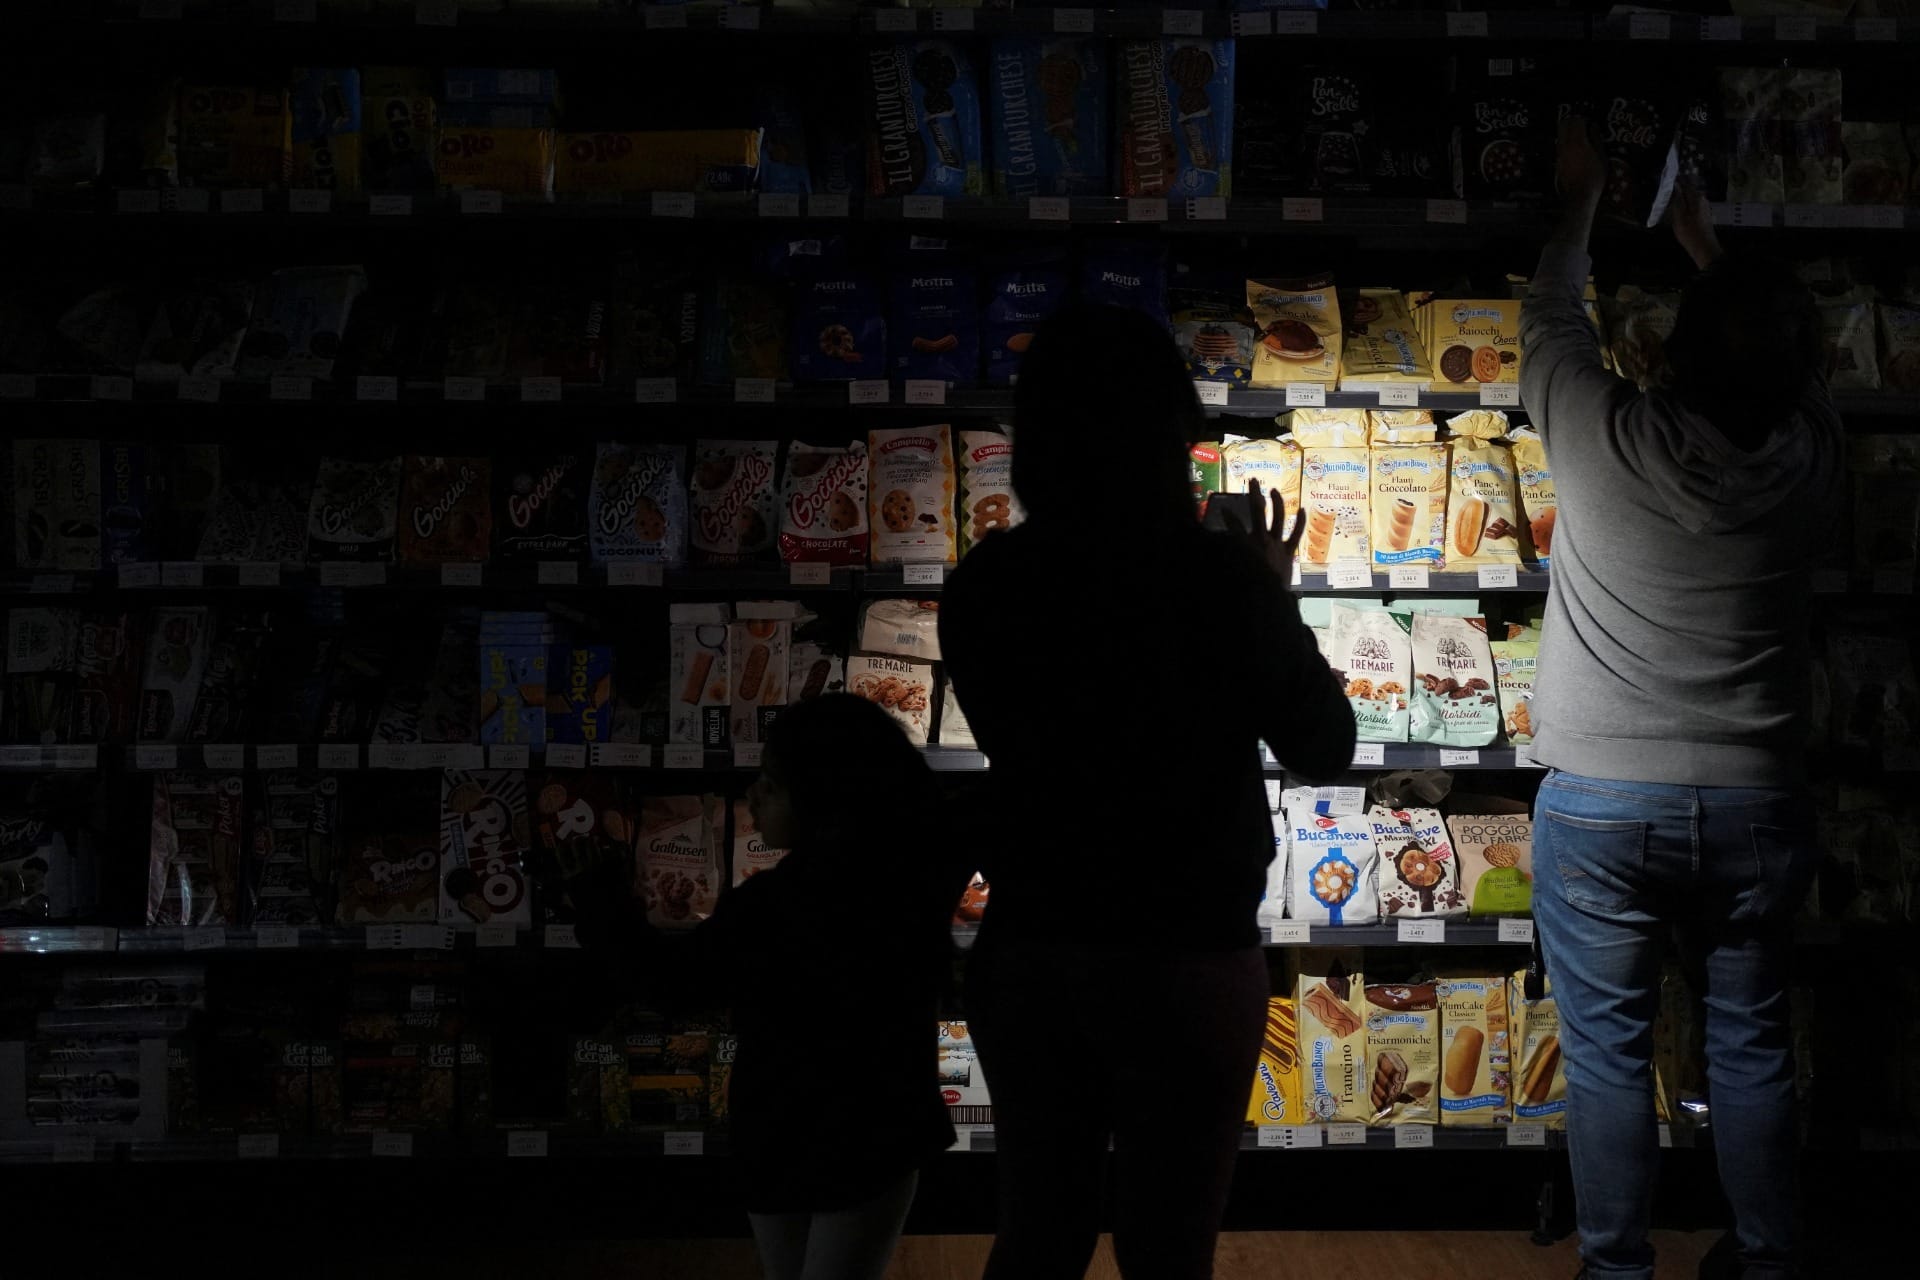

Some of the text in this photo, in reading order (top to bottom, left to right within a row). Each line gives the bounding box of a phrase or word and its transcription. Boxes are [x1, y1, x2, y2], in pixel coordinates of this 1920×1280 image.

[869, 48, 910, 164] GRANTURCHESE
[1311, 94, 1360, 116] Stelle
[998, 51, 1037, 175] GRANTURCHESE
[1127, 40, 1165, 190] IL GRANTURCHESE
[888, 166, 913, 185] IL
[911, 277, 954, 288] Motta
[1102, 271, 1141, 286] Motta
[1007, 282, 1047, 293] Motta
[1459, 326, 1500, 336] Baiocchi
[1493, 336, 1517, 346] Choco
[886, 437, 931, 450] Campiello
[1392, 476, 1414, 484] Flauti
[1474, 479, 1493, 488] Pane
[790, 453, 860, 531] Gocciole
[1328, 483, 1350, 491] Flauti
[1379, 483, 1427, 493] Cioccolato
[699, 454, 768, 543] Gocciole
[1310, 490, 1367, 500] Stracciatella
[801, 538, 848, 549] CHOCOLATE
[599, 547, 665, 556] COCONUT
[867, 659, 914, 673] TRE MARIE
[1350, 659, 1395, 673] TRE MARIE
[1448, 658, 1477, 670] MARIE
[1511, 658, 1535, 669] MULINO
[571, 649, 588, 702] PICK
[1439, 708, 1482, 720] Morbidi
[217, 792, 234, 835] Poker
[1296, 828, 1370, 842] Bucaneve
[1372, 822, 1441, 839] Bucaneve
[1462, 824, 1529, 836] POGGIO
[1461, 834, 1485, 845] DEL
[464, 800, 518, 906] RINGO
[1440, 1001, 1485, 1011] PlumCake
[1404, 1015, 1425, 1024] BIANCO
[1526, 1011, 1558, 1020] PlumCa
[583, 1040, 614, 1053] Gran
[1367, 1035, 1432, 1046] Fisarmoniche
[1312, 1041, 1326, 1096] MULINO BIANCO
[1340, 1044, 1354, 1104] Trancino
[1259, 1062, 1286, 1121] Pavesini
